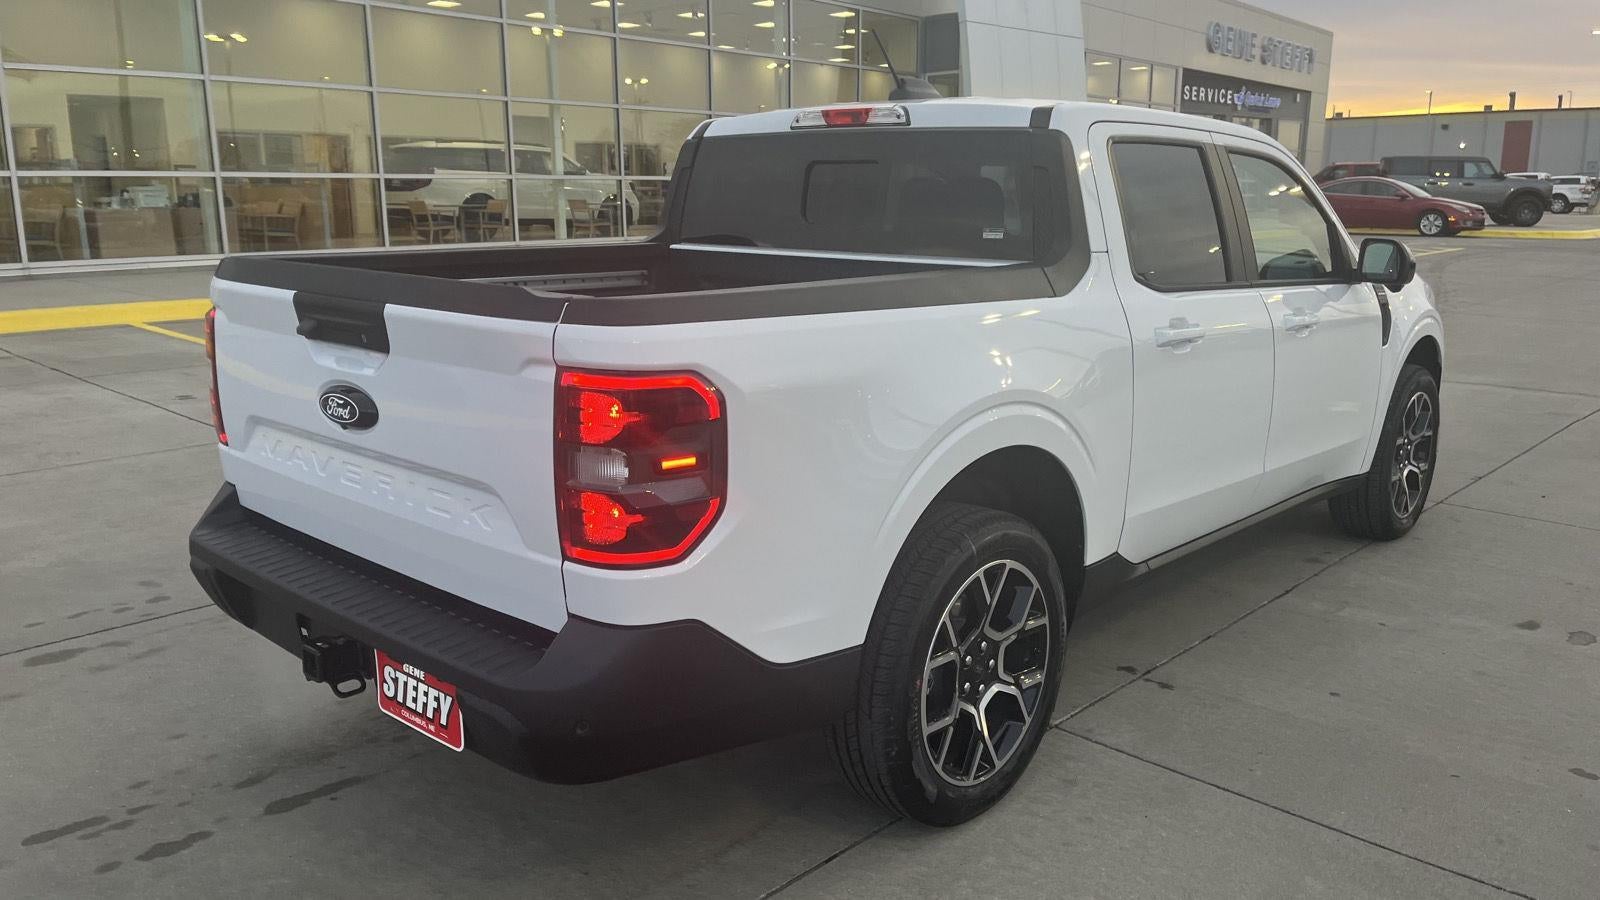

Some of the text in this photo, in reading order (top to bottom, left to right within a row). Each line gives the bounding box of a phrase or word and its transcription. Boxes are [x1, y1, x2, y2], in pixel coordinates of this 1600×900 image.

[1206, 21, 1257, 62] GENE
[1183, 84, 1233, 104] SERVICE
[326, 396, 351, 419] Ford
[261, 434, 494, 532] MAVERICK
[402, 663, 426, 681] GENE
[383, 665, 453, 726] STEFFY
